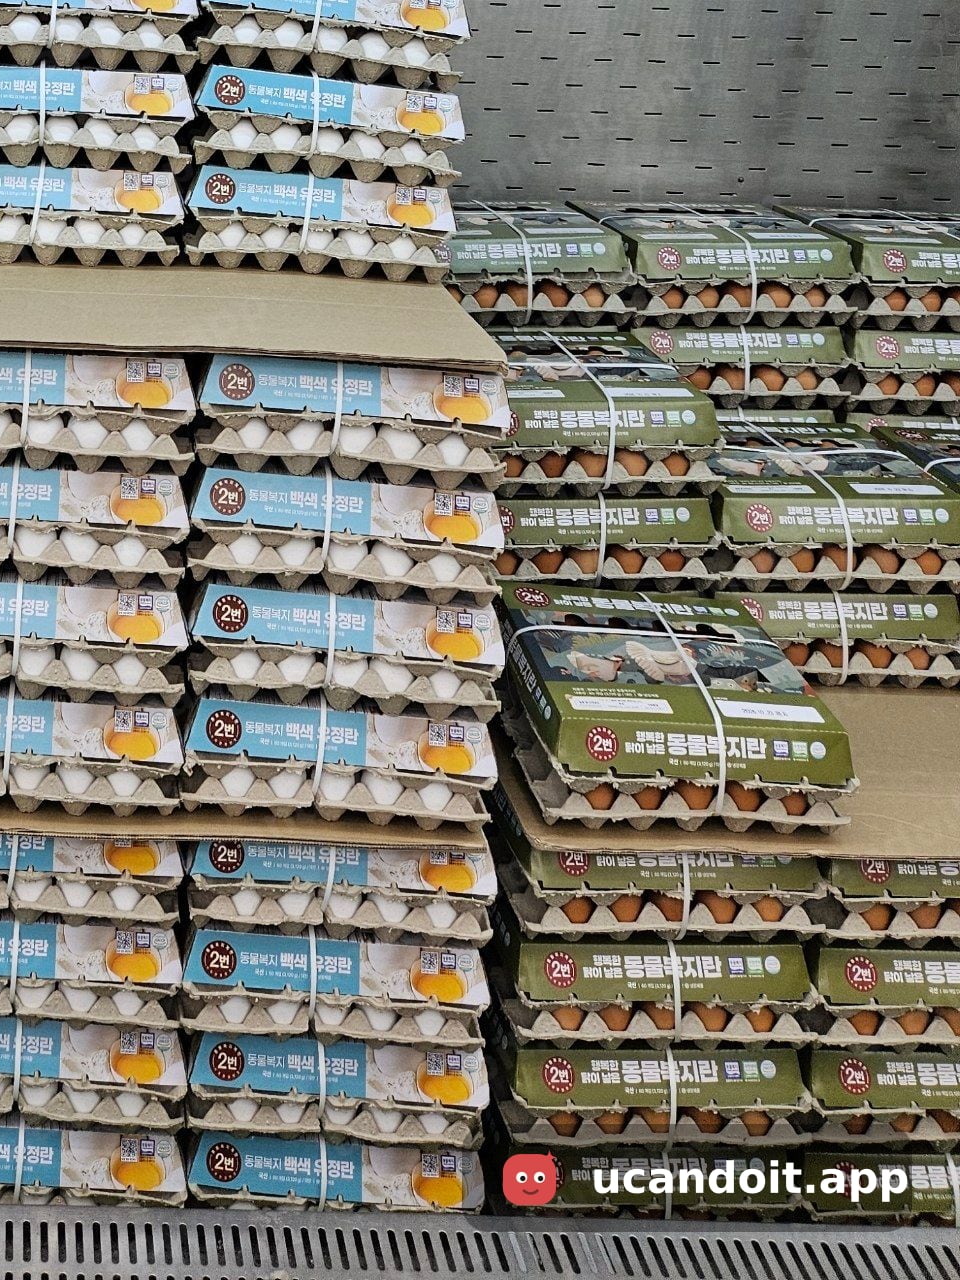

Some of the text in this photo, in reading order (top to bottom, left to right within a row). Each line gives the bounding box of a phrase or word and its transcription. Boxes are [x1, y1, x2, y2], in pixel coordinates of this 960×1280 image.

[212, 182, 229, 196] 2번
[662, 253, 677, 264] 2번
[227, 373, 248, 390] 2번
[299, 375, 328, 393] 백색
[751, 511, 769, 525] 2번
[813, 507, 899, 525] 동물복지란
[221, 604, 241, 622] 2번
[292, 608, 321, 626] 백색
[593, 735, 613, 752] 2번
[667, 733, 767, 759] 동물복지란
[209, 951, 229, 969] 2번
[280, 953, 308, 971] 백색
[624, 955, 723, 978] 동물복지란
[551, 961, 570, 978] 2번
[550, 1066, 570, 1083] 2번
[621, 1060, 718, 1083] 동물복지란
[214, 1153, 234, 1171] 2번
[284, 1156, 311, 1175] 백색
